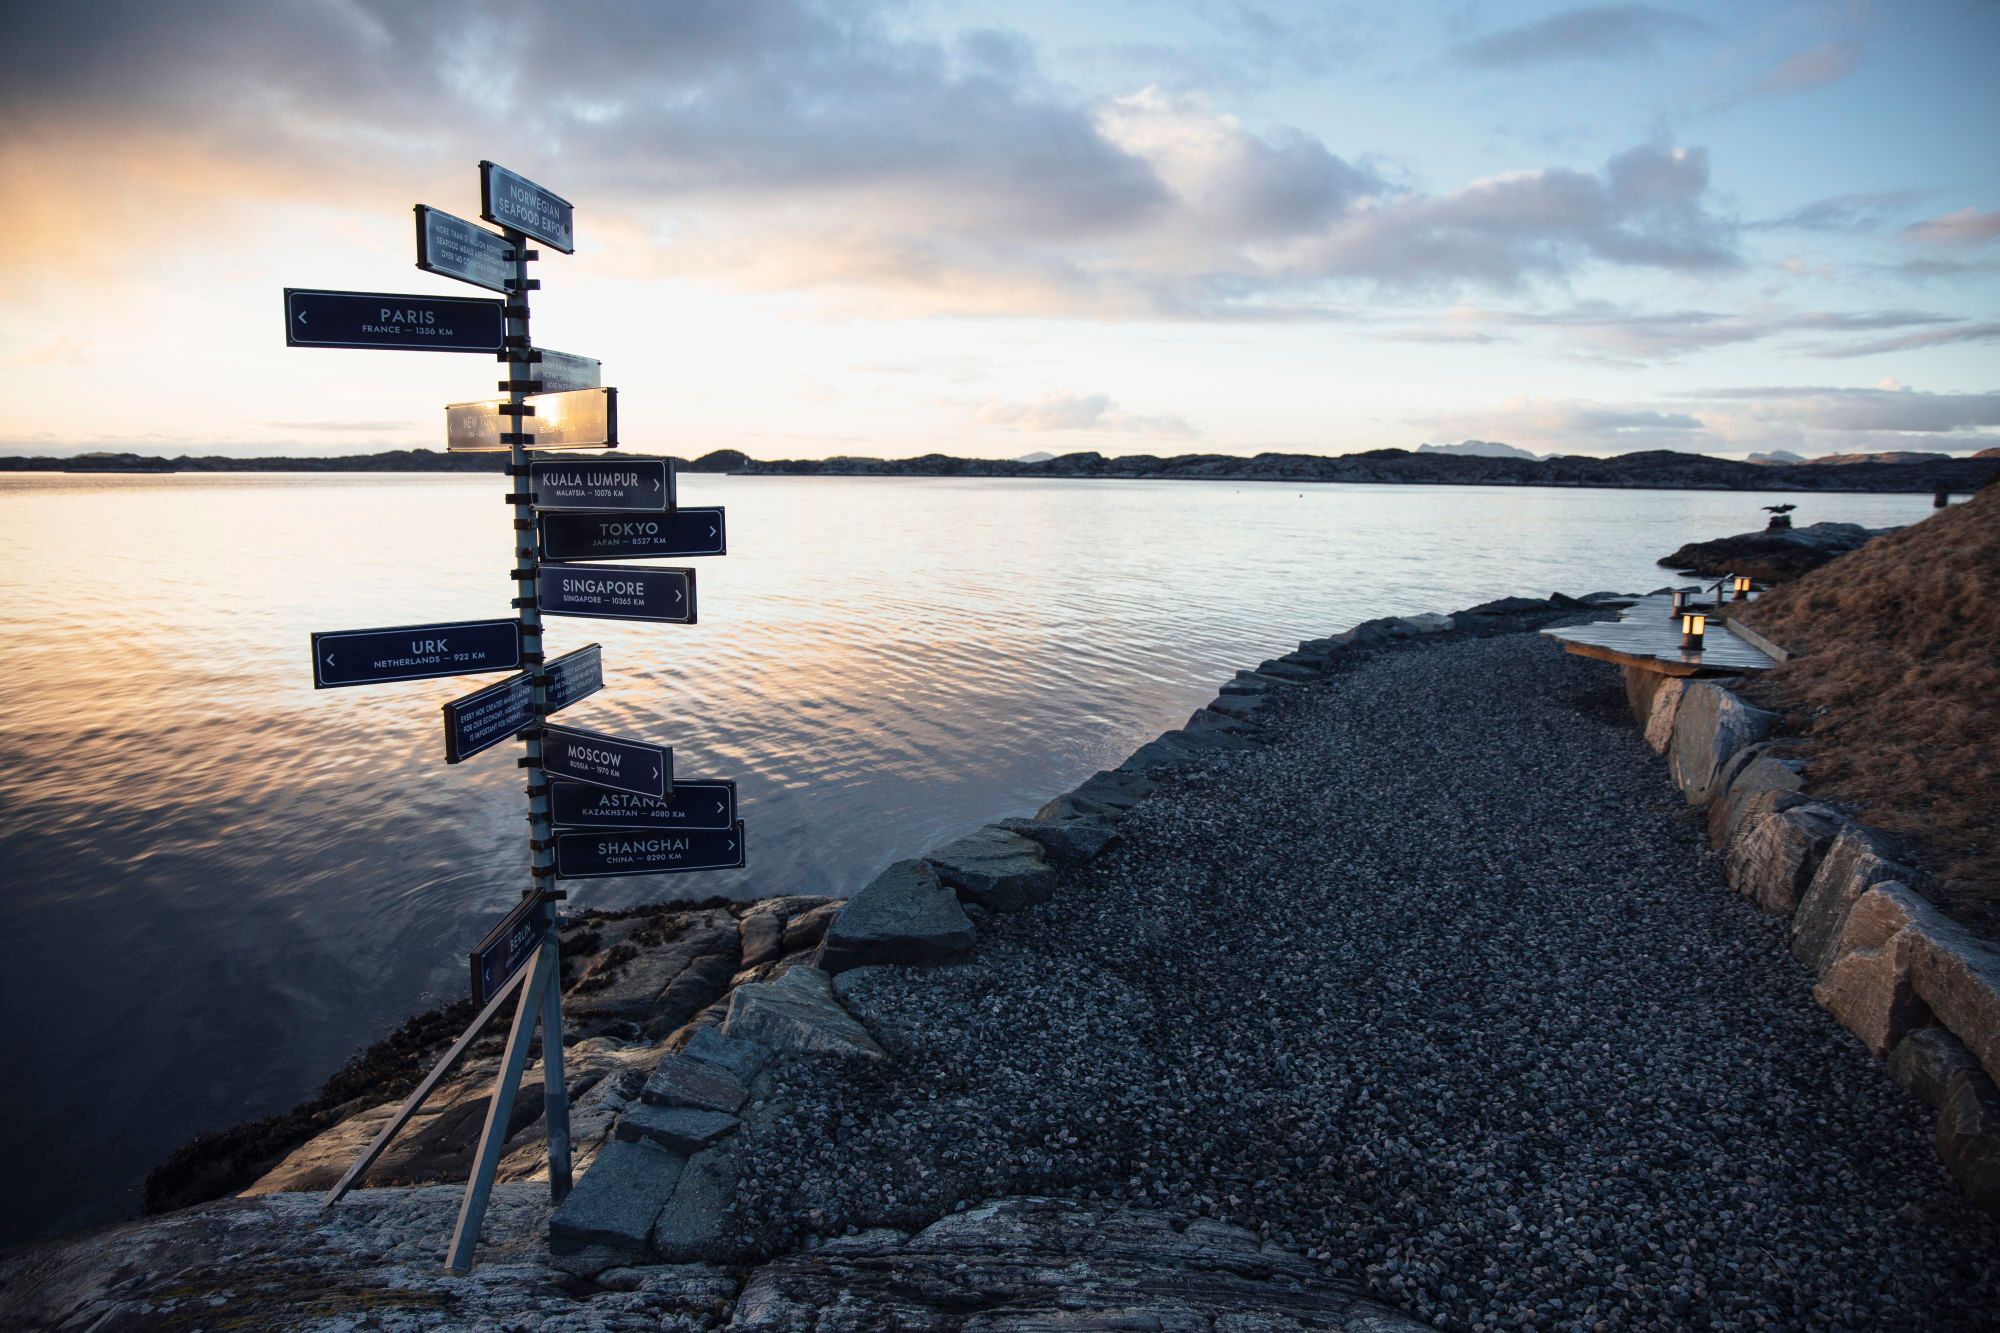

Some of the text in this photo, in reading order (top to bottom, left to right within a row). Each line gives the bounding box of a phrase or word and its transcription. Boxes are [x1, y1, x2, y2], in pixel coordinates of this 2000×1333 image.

[510, 184, 559, 218] NORWEGIAN
[499, 198, 539, 226] SEAFOOD
[435, 223, 449, 236] MORE
[436, 235, 458, 250] SEAFOOD
[381, 309, 435, 324] PARIS
[362, 325, 400, 333] FRANCE
[464, 416, 477, 429] NEW
[543, 473, 638, 486] KUALA LUMPUR
[600, 523, 658, 536] TOKYO
[563, 579, 644, 595] SINGAPORE
[563, 595, 601, 603] SINGAPORE
[412, 639, 448, 654] URK
[374, 656, 440, 668] NETHERLANDS
[568, 744, 621, 767] MOSCOW
[570, 760, 588, 770] RUSSIA
[597, 766, 609, 775] 1970
[598, 838, 689, 855] SHANGHAI
[511, 920, 530, 952] BERLIN
